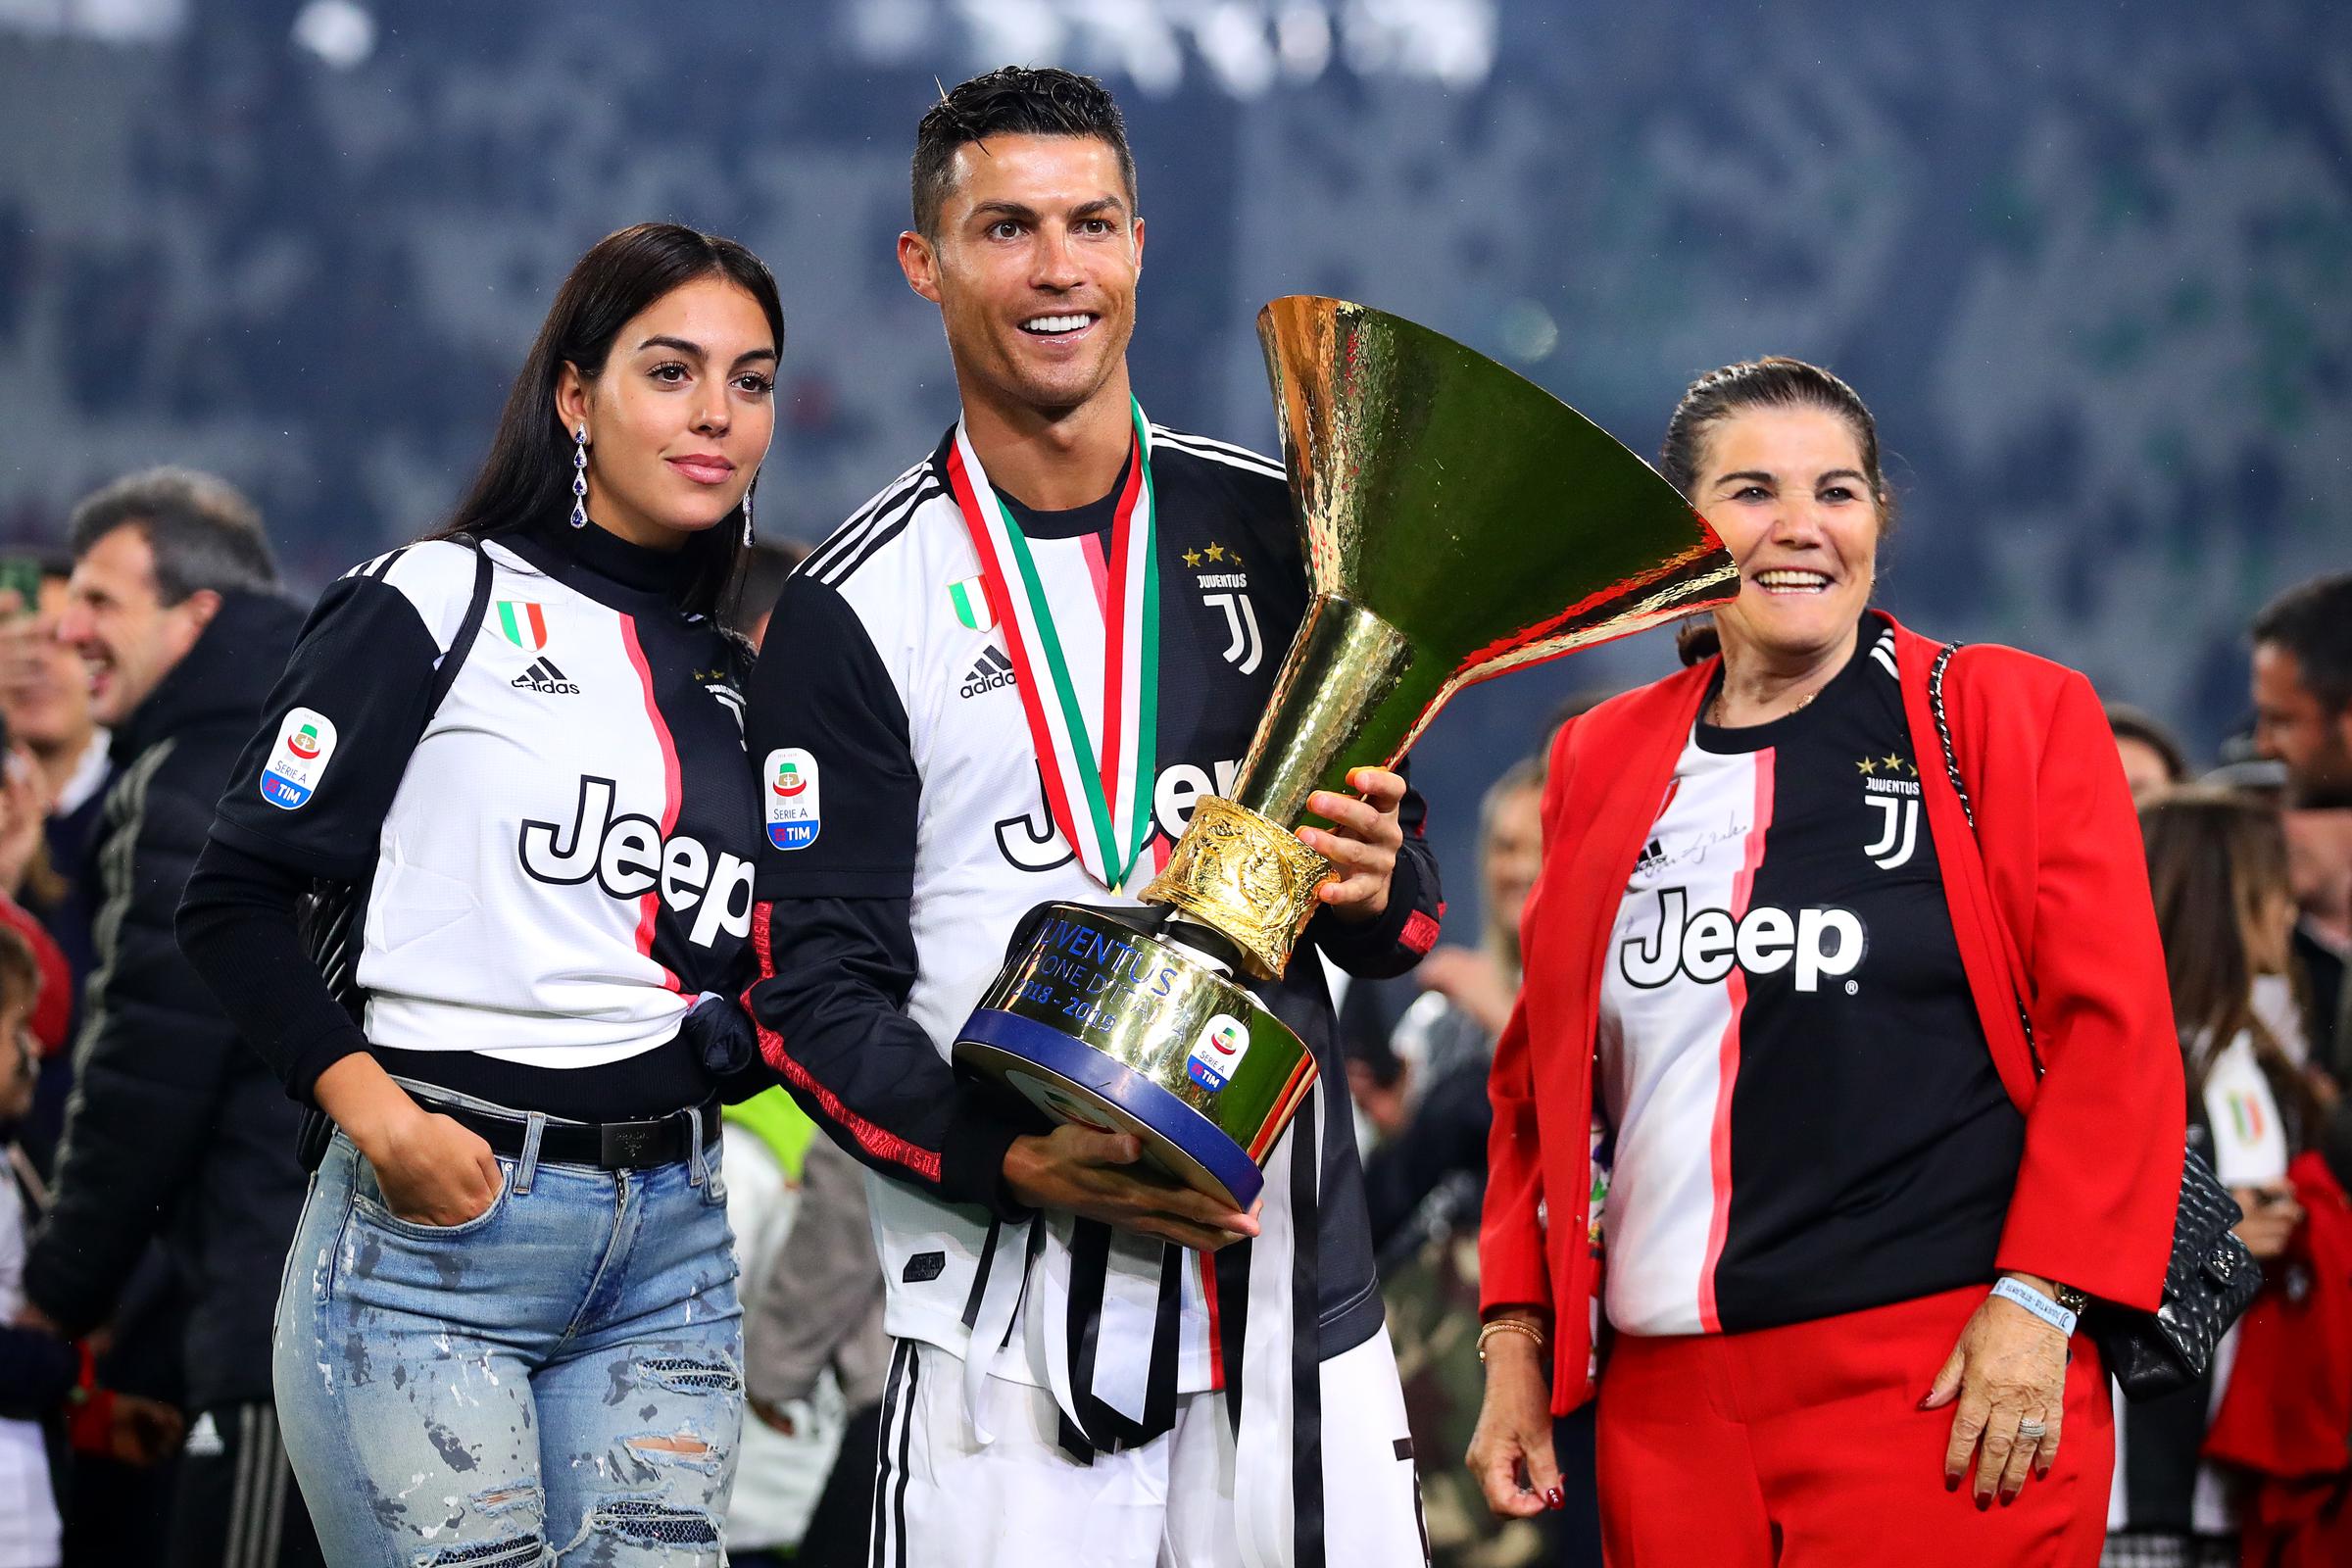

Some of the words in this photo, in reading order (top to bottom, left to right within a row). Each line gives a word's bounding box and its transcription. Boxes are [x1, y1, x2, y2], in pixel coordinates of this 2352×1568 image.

[1196, 573, 1248, 589] JUVENTUS
[960, 671, 1016, 699] adida
[274, 760, 298, 780] SERIE
[298, 772, 307, 784] A
[277, 783, 301, 804] TIM
[1865, 776, 1920, 796] JUVENTUS
[773, 808, 797, 820] SERIE
[800, 808, 808, 818] A
[994, 758, 1244, 873] Je
[786, 826, 810, 841] TIM
[518, 773, 755, 949] Jeep
[1620, 886, 1865, 993] Jeep
[1062, 996, 1117, 1033] 2019
[1199, 1050, 1219, 1067] SERIE
[1201, 1069, 1220, 1088] TIM
